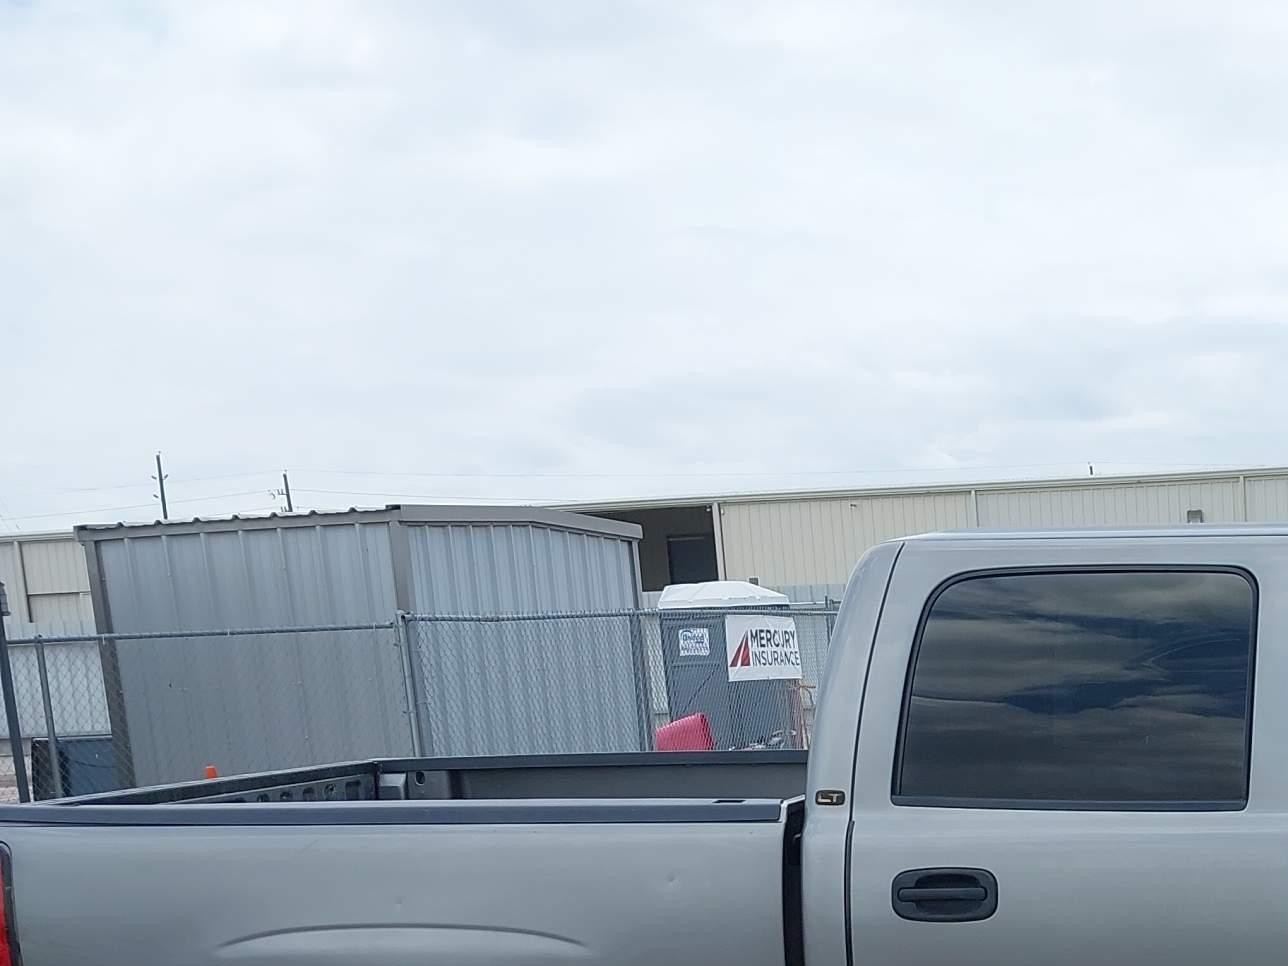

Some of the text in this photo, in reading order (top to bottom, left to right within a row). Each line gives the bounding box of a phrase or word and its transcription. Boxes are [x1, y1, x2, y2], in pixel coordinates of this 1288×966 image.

[749, 628, 796, 649] MERCURY
[751, 650, 801, 667] INSURANCE
[817, 793, 843, 803] LT
